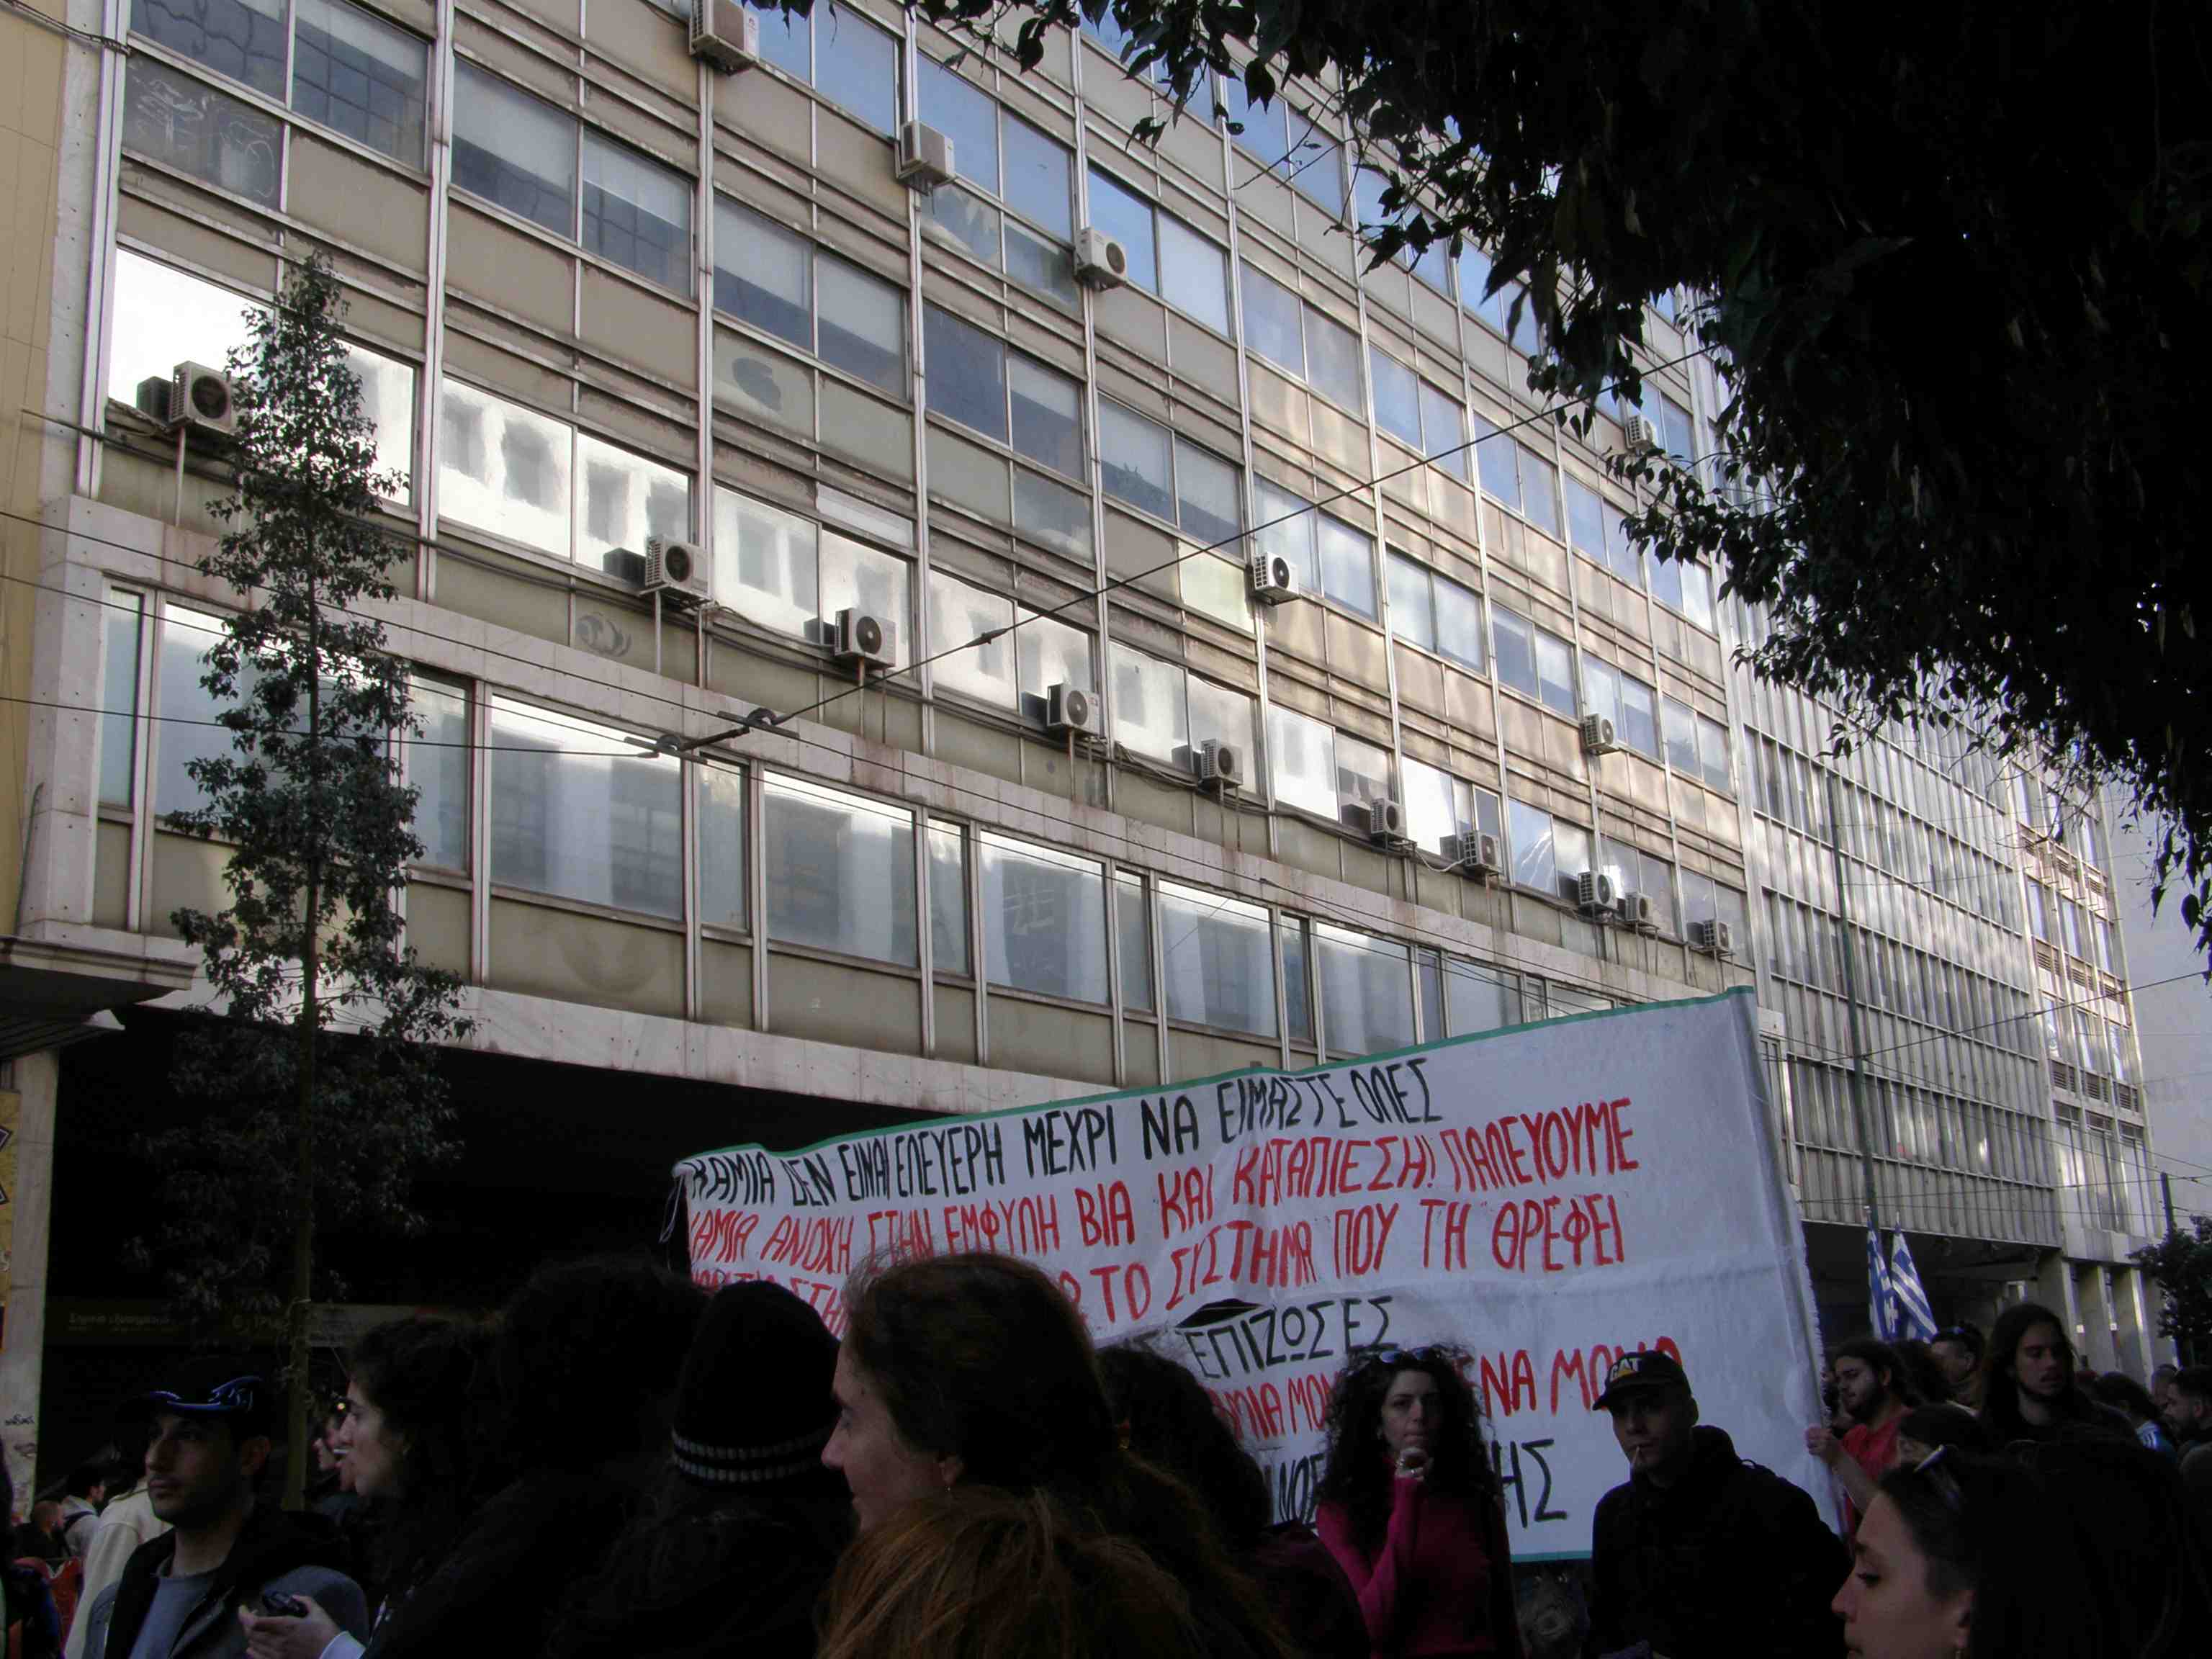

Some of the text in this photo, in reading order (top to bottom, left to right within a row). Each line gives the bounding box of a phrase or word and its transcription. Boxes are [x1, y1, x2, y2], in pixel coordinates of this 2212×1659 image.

[760, 1214, 854, 1274] ΑΝΟΧΗ
[1074, 1179, 1136, 1248] ΒΙΑ
[1157, 1163, 1214, 1240] ΚΑΙ
[1233, 1134, 1437, 1208] ΚΑΤΑΠΙΕΣΗ!
[1439, 1097, 1640, 1193] ΠΑΛΕΥΟΥΜΕ
[780, 1154, 837, 1207] ΔΕΝ
[838, 1136, 891, 1201] ΕΙΝΑΙ
[1022, 1104, 1117, 1178] ΜΕΧΡΙ
[1140, 1094, 1200, 1160] ΝΑ
[1217, 1073, 1357, 1143] ΕΙΜΑΣΤΕ
[1350, 1058, 1442, 1124] ΟΛΕΣ
[1090, 1263, 1152, 1323] ΤΟ
[1334, 1202, 1399, 1279] ΠΟΥ
[1419, 1198, 1472, 1272] ΤΗ
[1491, 1192, 1624, 1273] ΘΡΕΦΕΙ
